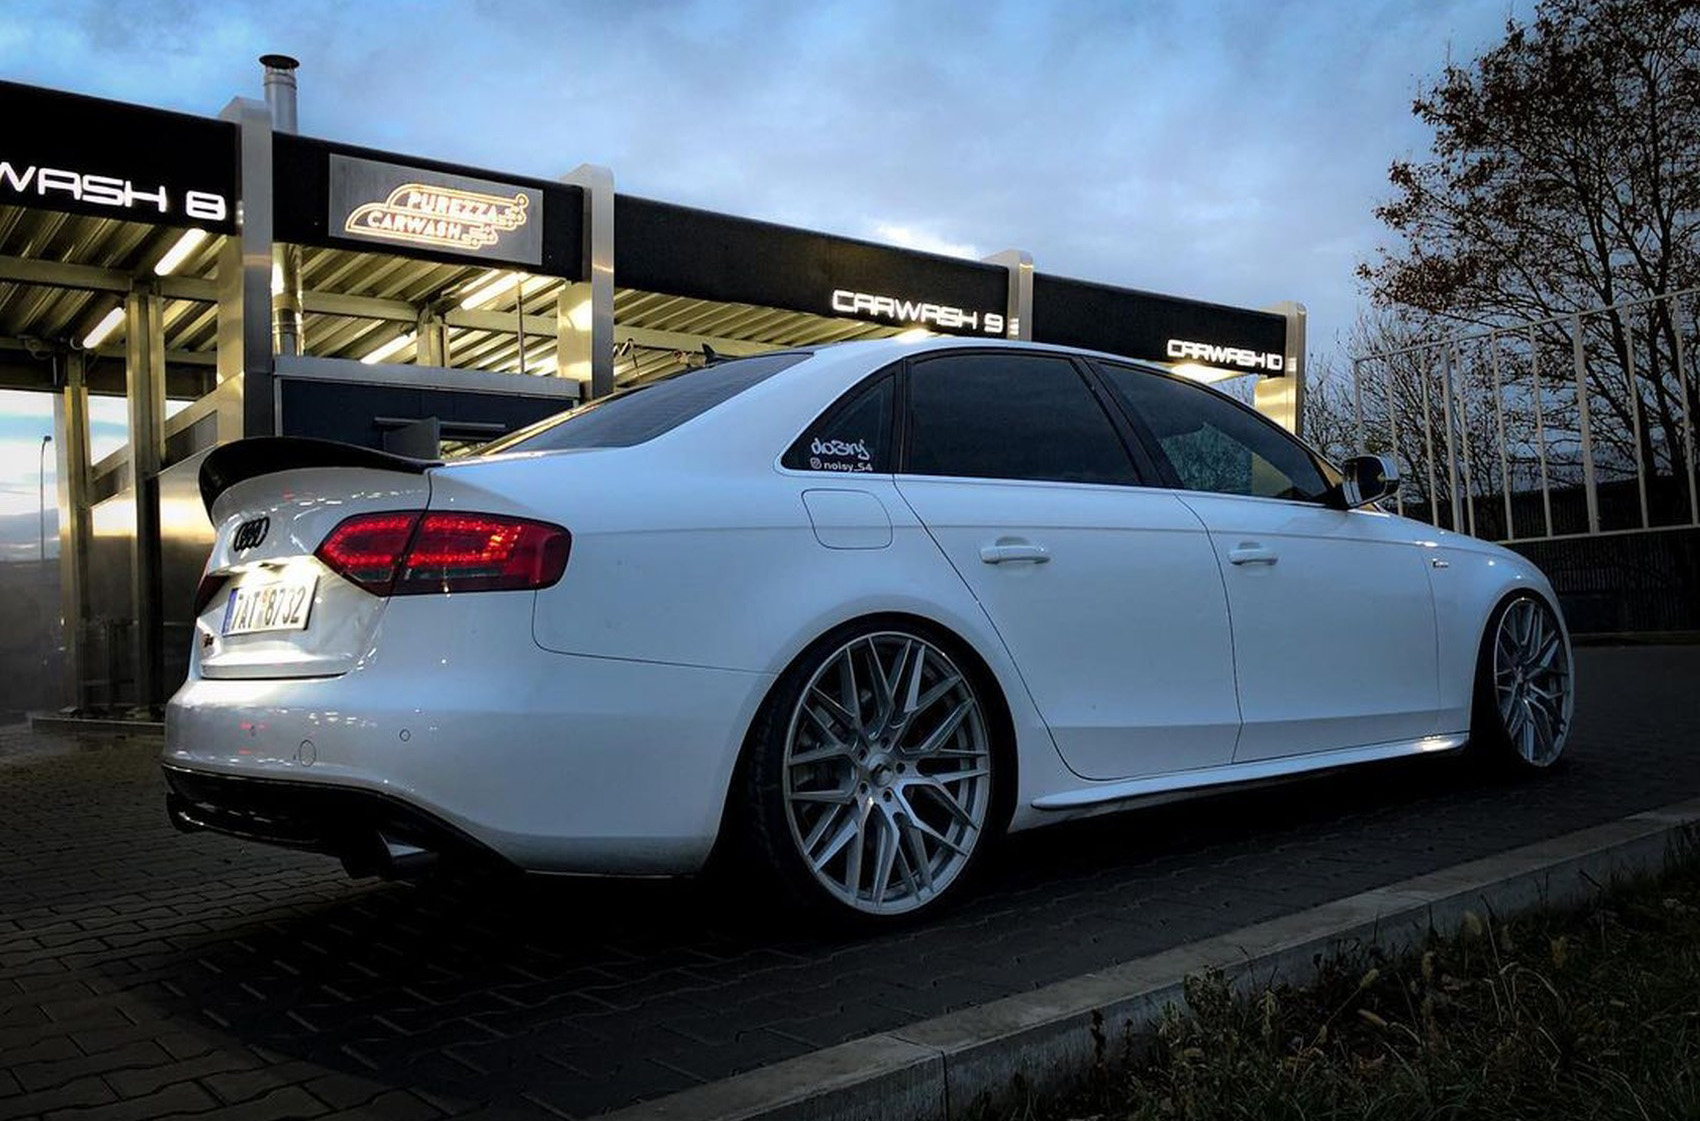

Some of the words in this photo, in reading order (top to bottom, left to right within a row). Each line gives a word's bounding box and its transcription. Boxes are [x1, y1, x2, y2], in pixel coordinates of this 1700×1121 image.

[186, 190, 226, 221] 8
[407, 191, 498, 222] PUREZZA
[367, 210, 462, 240] CARWASH
[832, 289, 978, 330] CARWASH
[984, 313, 1004, 333] 9
[1167, 339, 1266, 368] CARWASH
[264, 586, 306, 626] 8732
